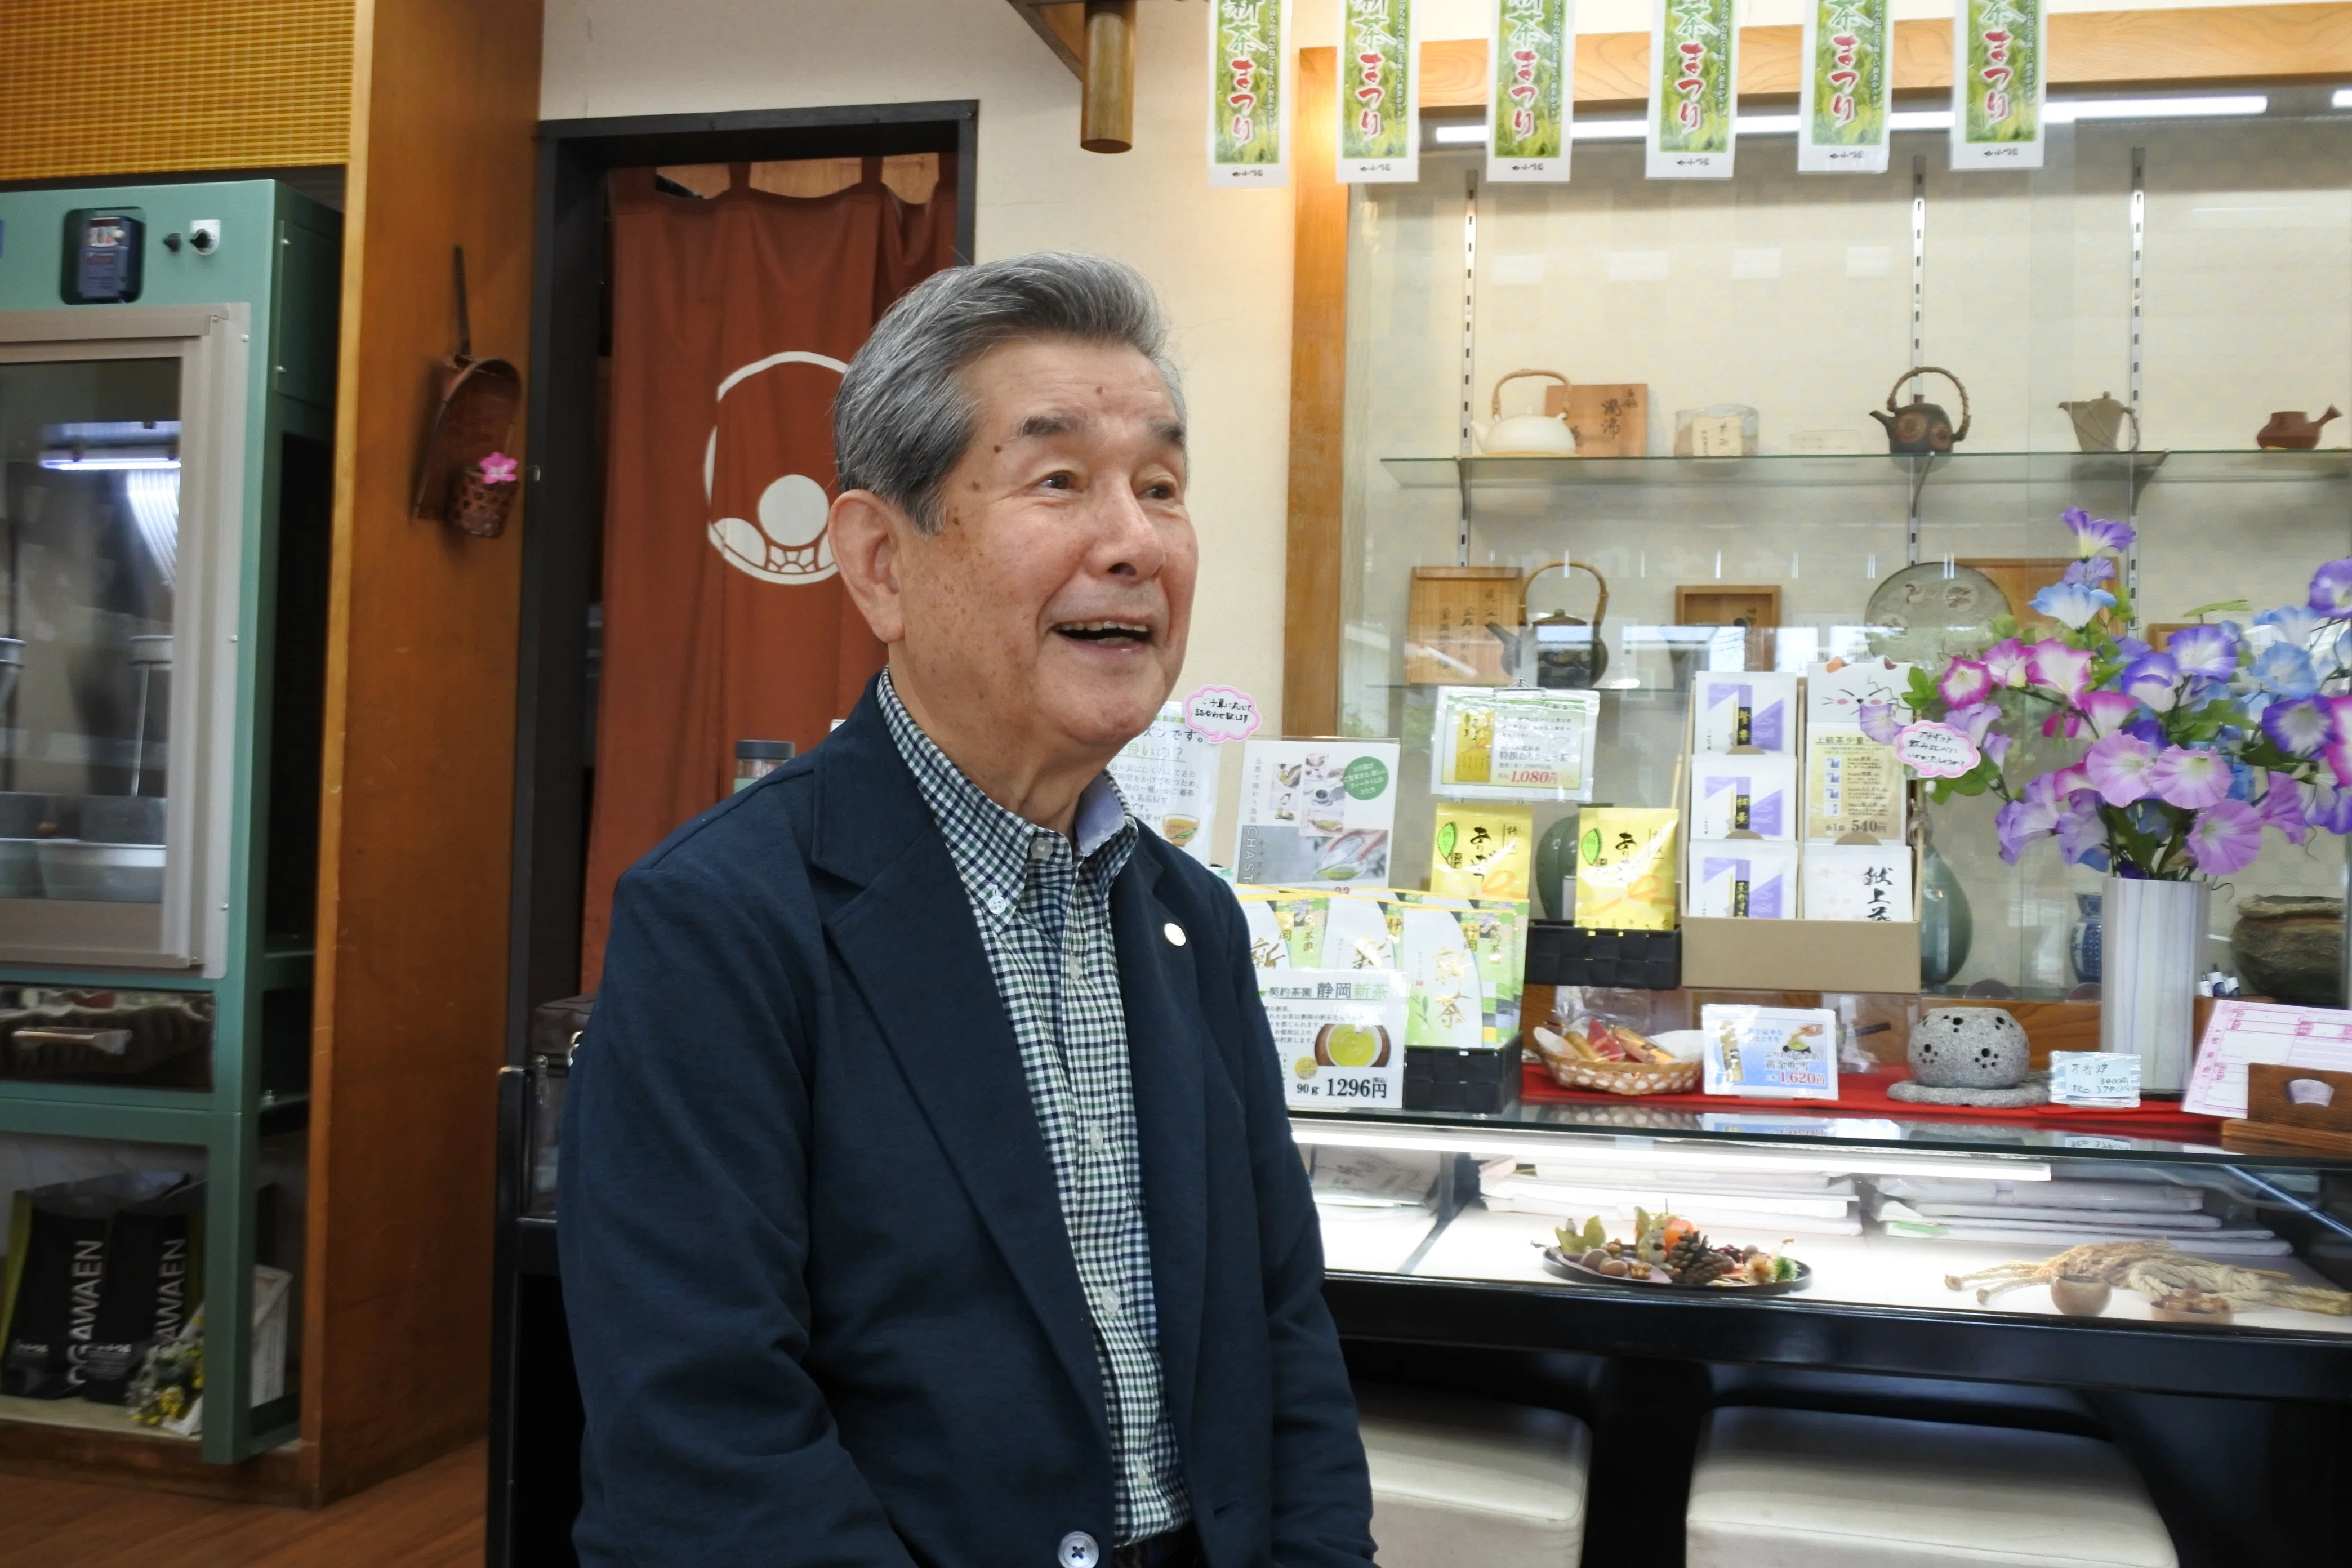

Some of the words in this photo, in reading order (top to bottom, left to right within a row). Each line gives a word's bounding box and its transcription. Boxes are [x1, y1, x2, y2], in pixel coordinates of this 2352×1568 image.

[1675, 0, 1719, 135] 茶まつり
[1863, 866, 1894, 921] 献上茶
[1269, 987, 1312, 997] 契約茶園
[1317, 982, 1388, 998] 静岡新茶
[1326, 1078, 1387, 1098] 1296円
[1780, 1072, 1825, 1085] 1,620円
